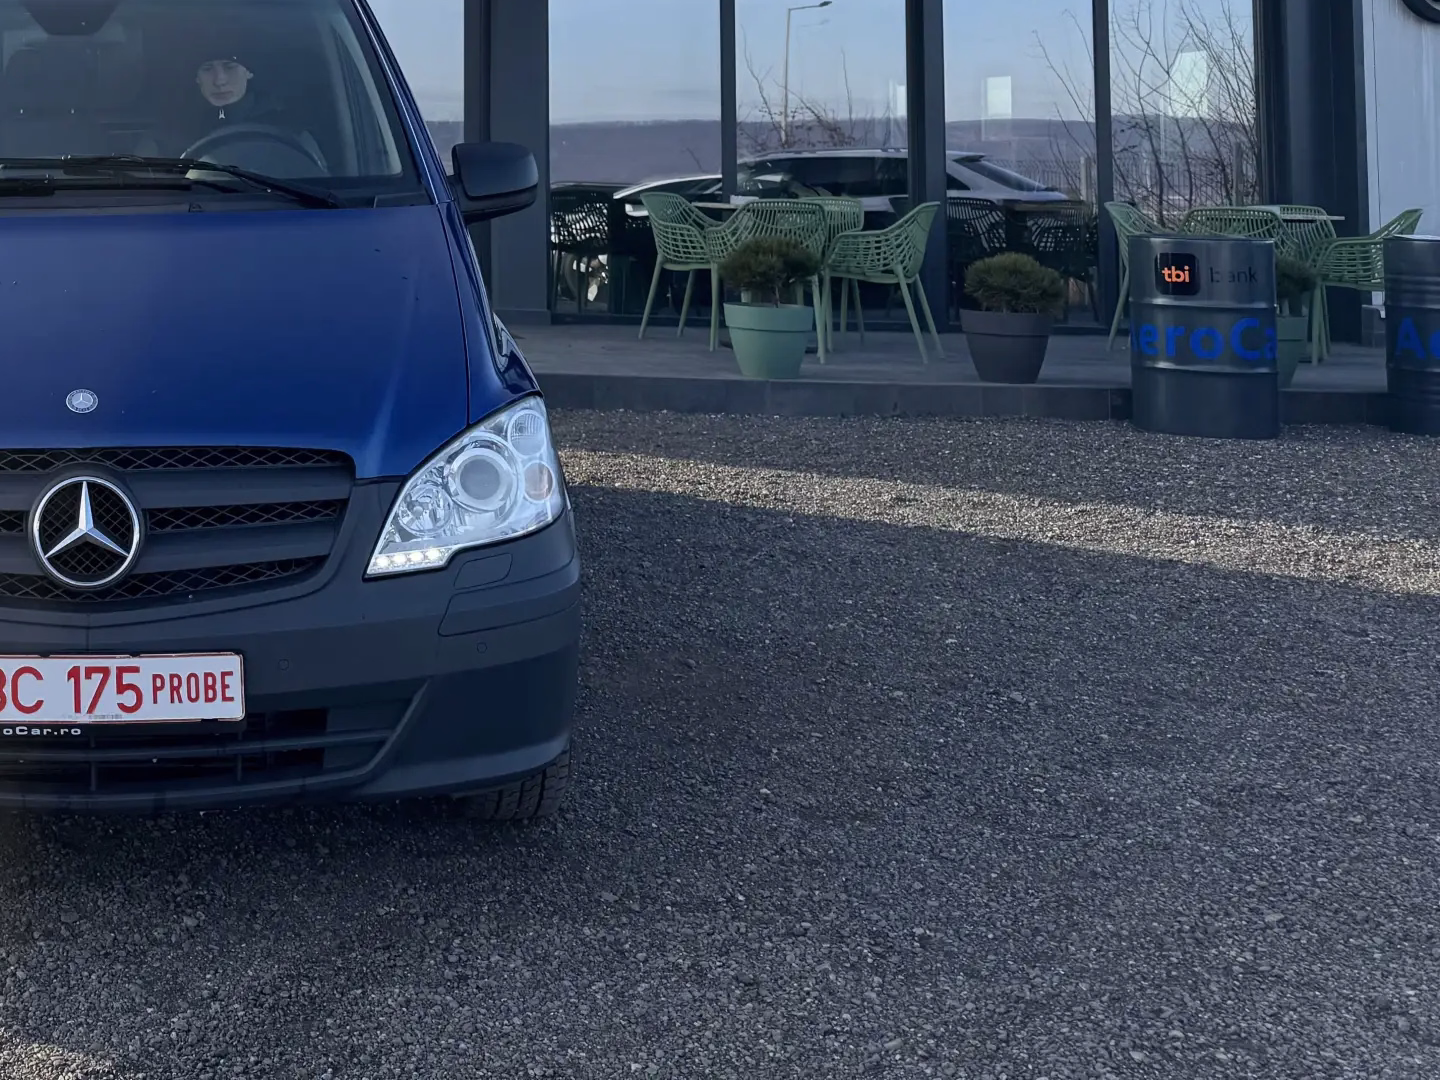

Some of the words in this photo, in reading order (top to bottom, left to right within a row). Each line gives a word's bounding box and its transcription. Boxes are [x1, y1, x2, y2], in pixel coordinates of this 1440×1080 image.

[1161, 265, 1190, 283] tbi
[67, 665, 143, 715] 175
[152, 670, 235, 705] PROBE
